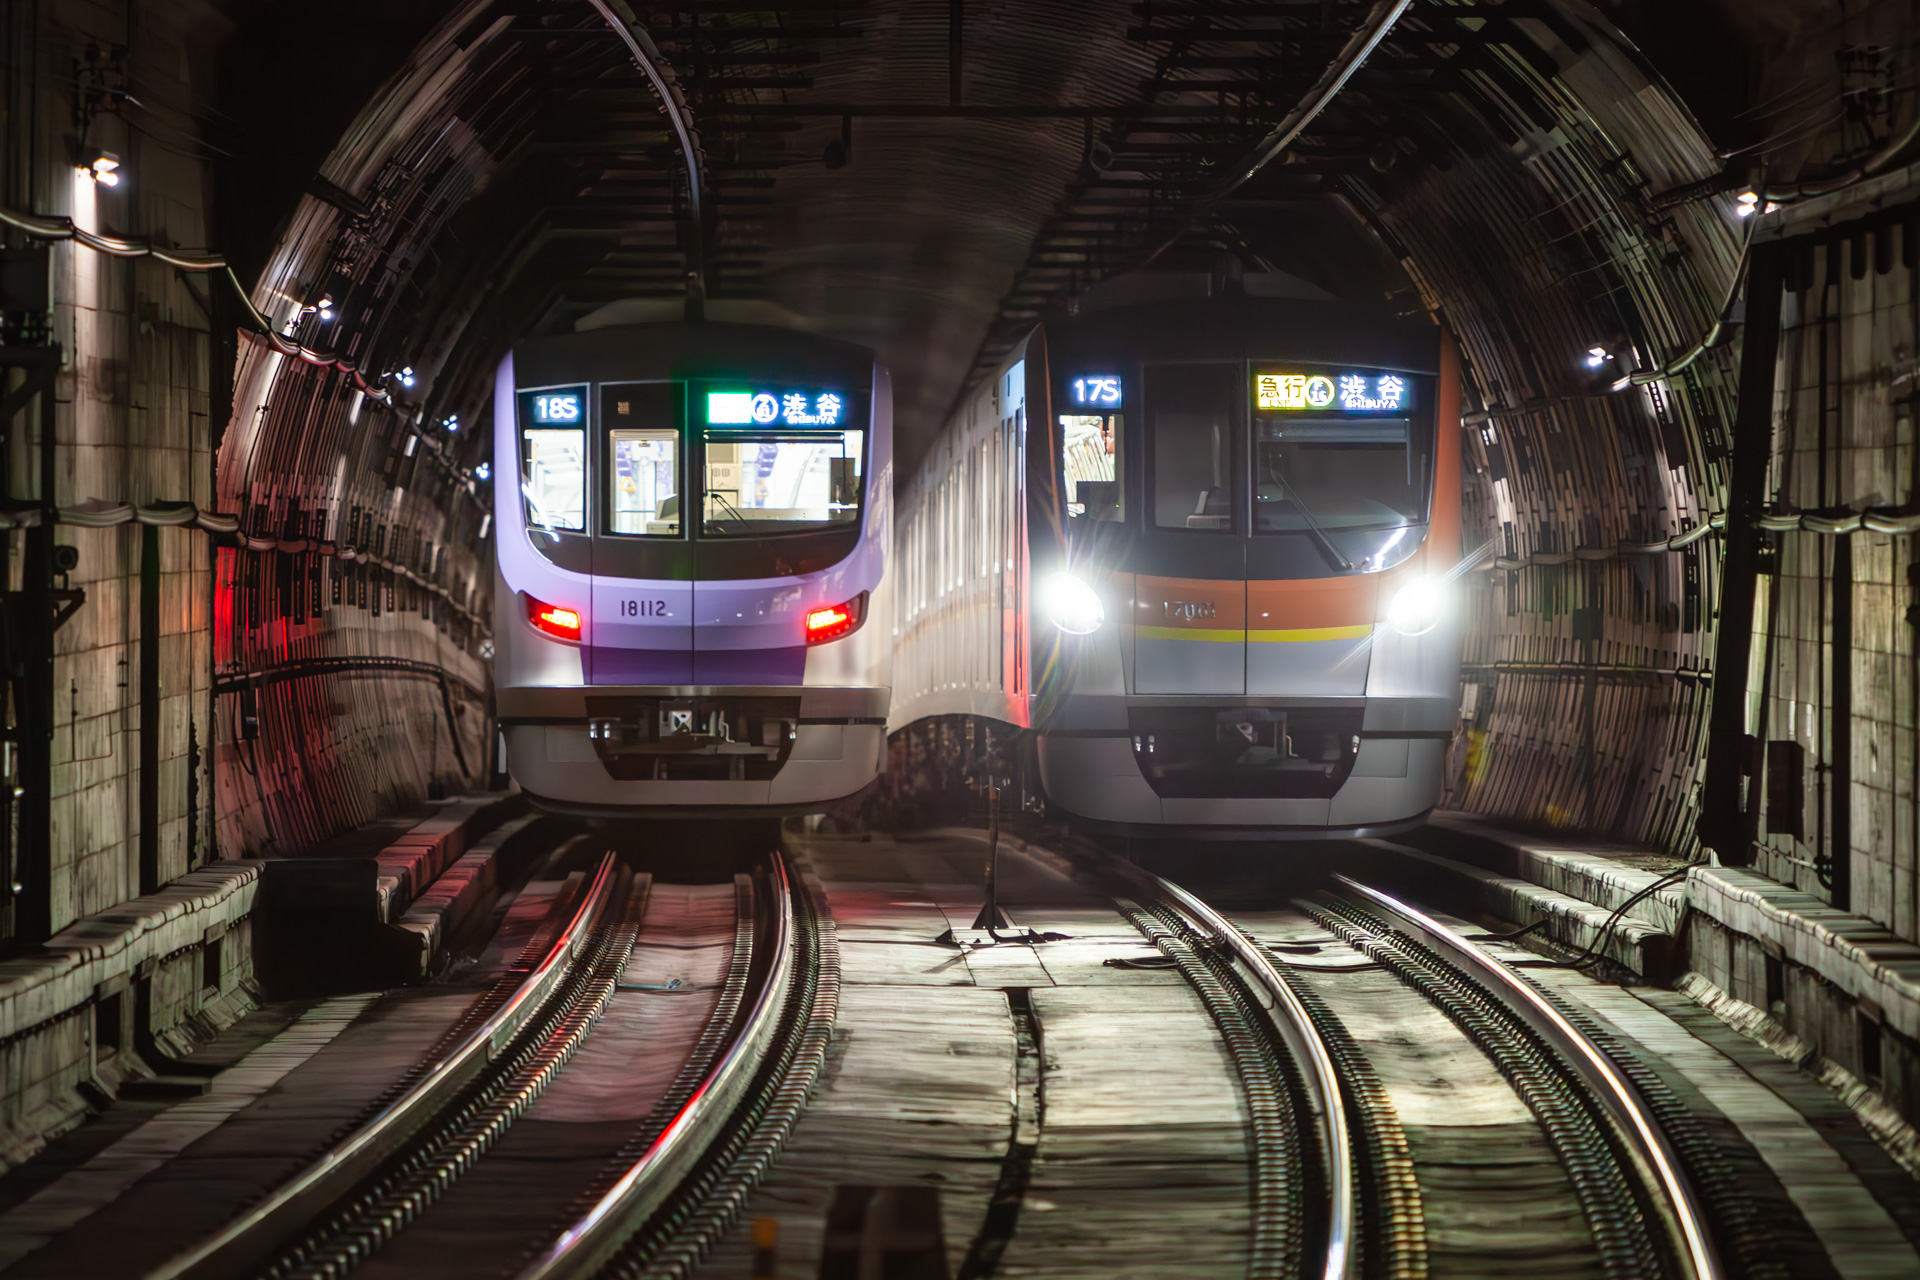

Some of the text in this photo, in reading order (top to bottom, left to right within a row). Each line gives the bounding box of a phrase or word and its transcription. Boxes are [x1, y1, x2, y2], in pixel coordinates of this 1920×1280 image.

[1074, 378, 1119, 401] 17S
[1260, 376, 1304, 398] 急行
[1340, 375, 1404, 401] 渋谷
[538, 397, 578, 419] 18S
[782, 393, 841, 417] 渋谷
[1345, 399, 1398, 409] SHIBUYA
[621, 600, 666, 617] 18112
